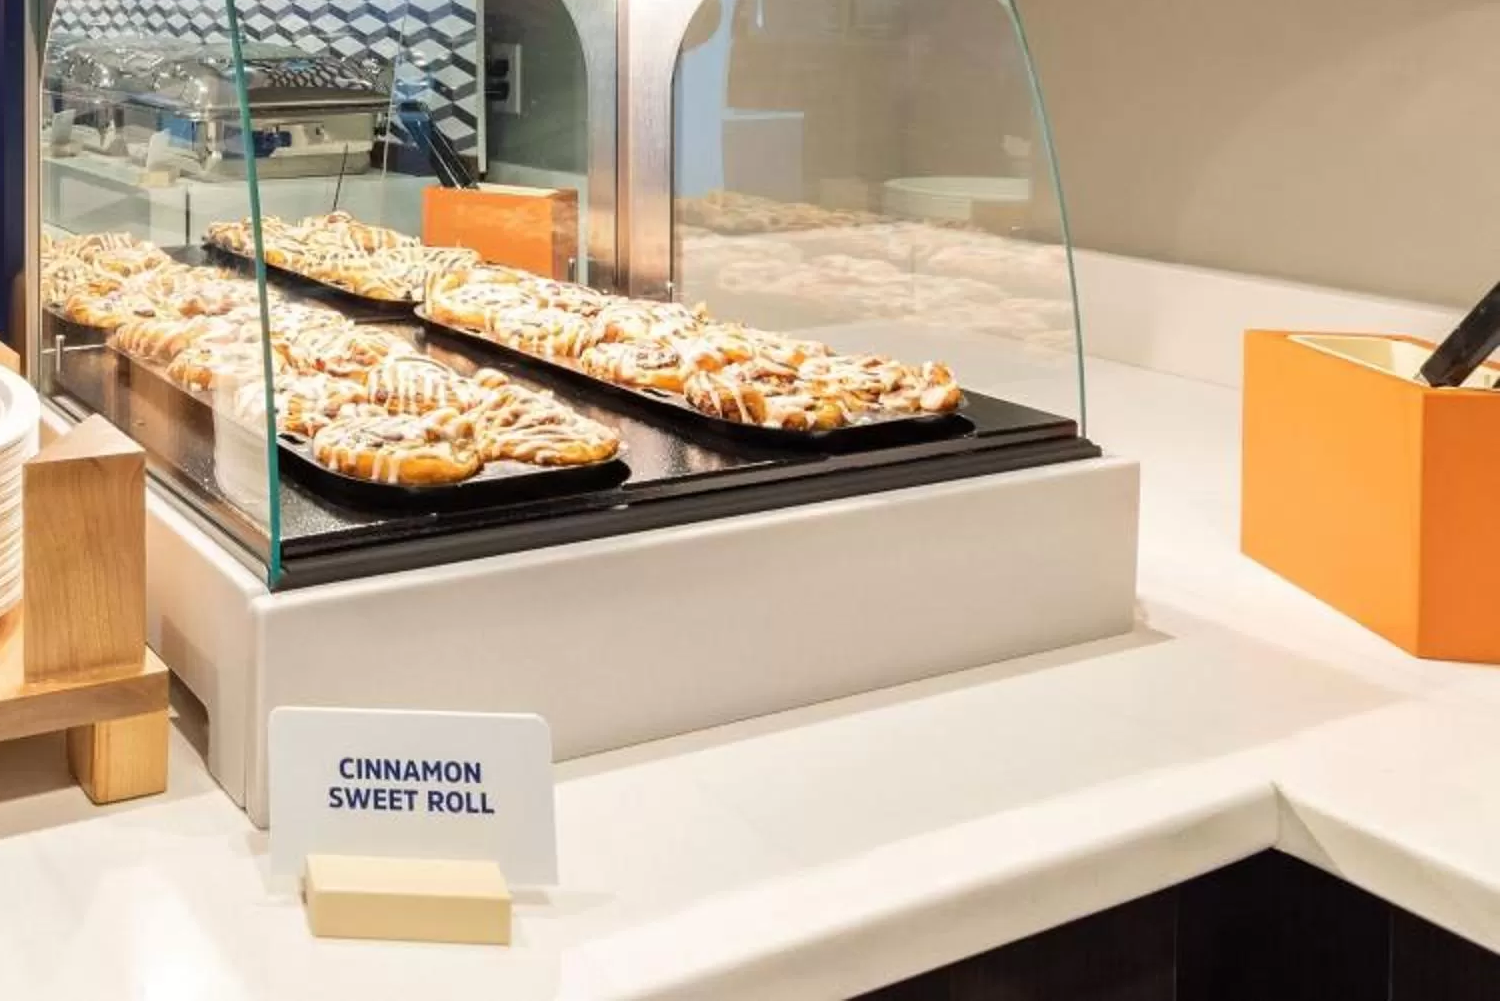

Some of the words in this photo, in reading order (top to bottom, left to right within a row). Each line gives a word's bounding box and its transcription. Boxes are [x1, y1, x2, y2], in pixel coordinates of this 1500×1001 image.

[338, 757, 482, 784] CINNAMON
[328, 787, 418, 812] SWEET
[427, 790, 495, 814] ROLL
